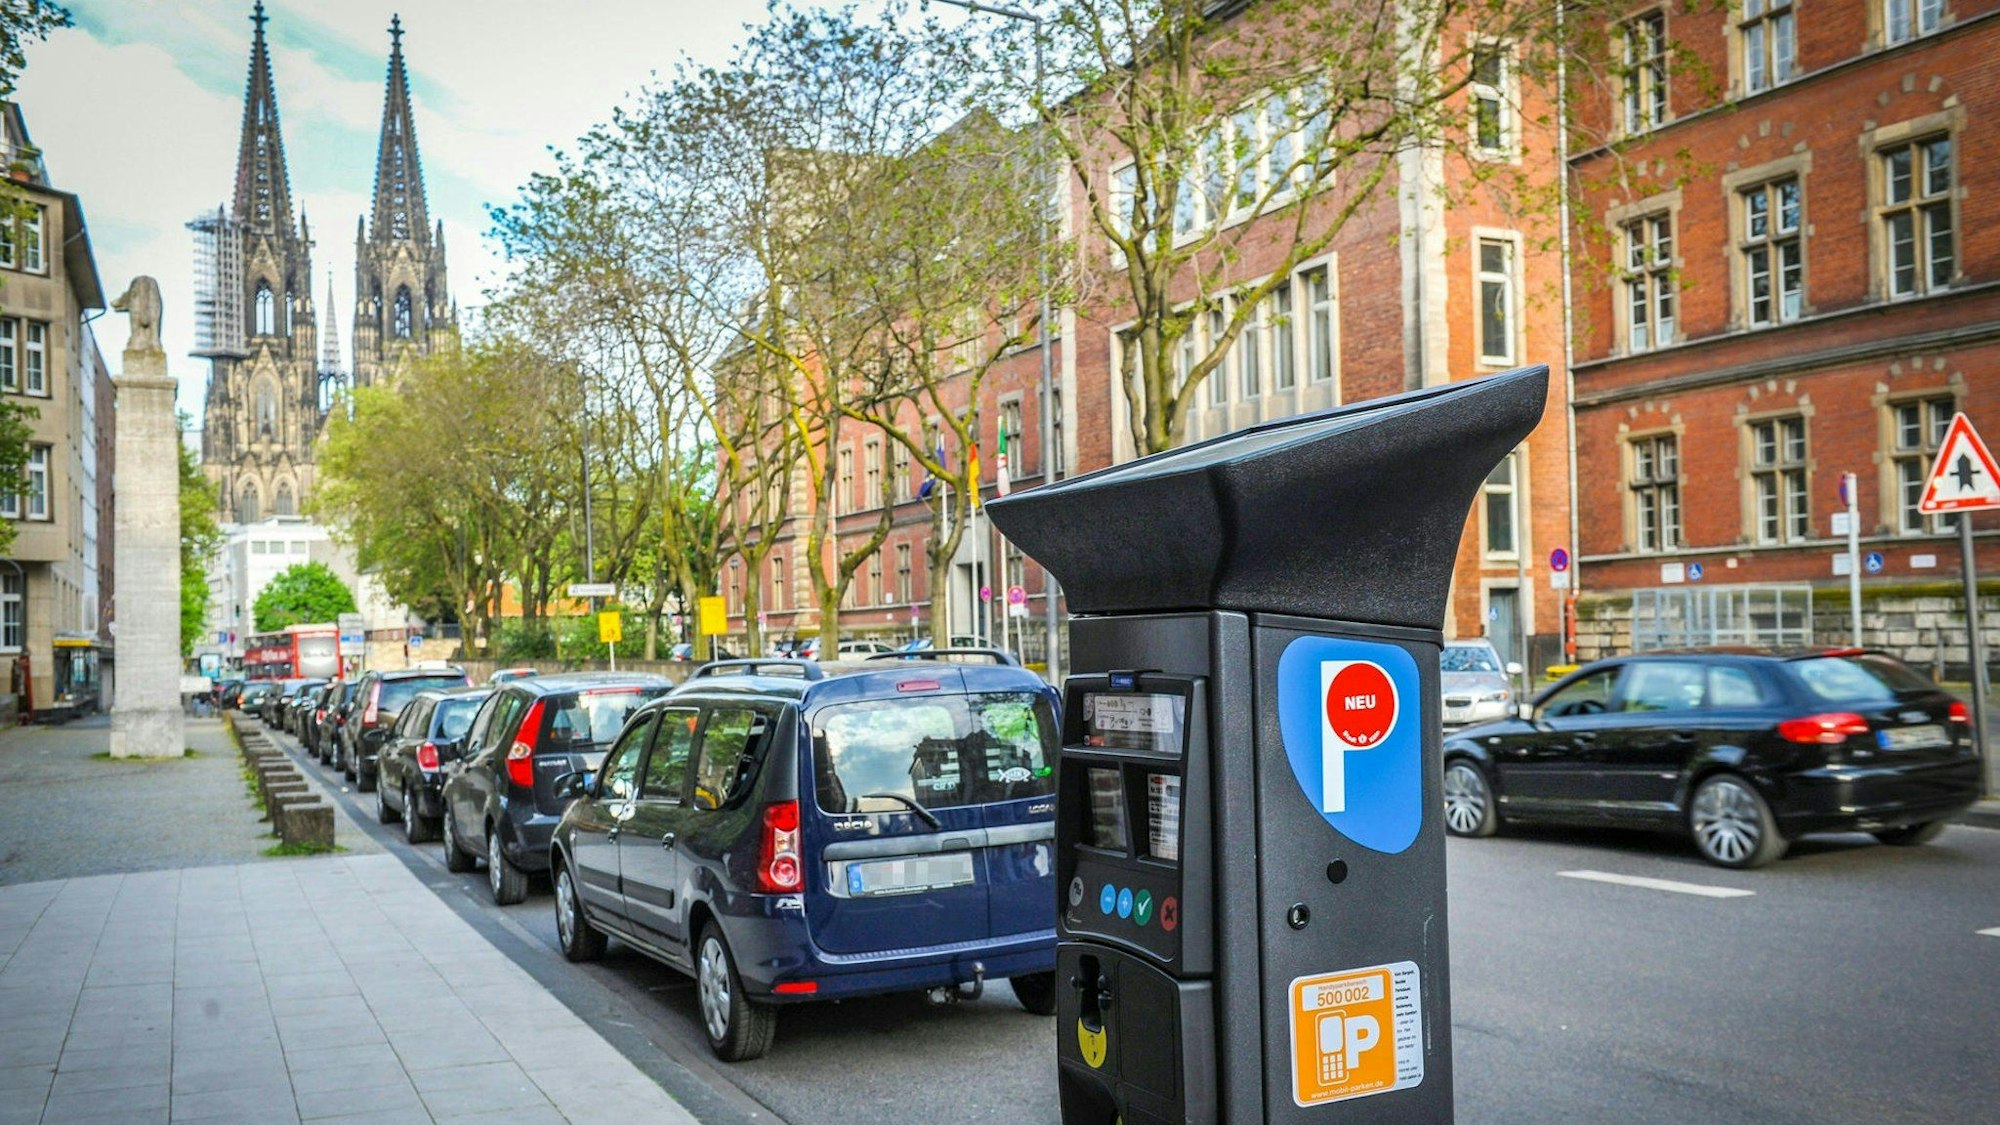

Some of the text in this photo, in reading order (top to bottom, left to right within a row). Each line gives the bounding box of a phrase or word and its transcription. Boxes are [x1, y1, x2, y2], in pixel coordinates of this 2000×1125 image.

[1344, 694, 1376, 710] NEU
[1321, 660, 1399, 812] P
[1317, 986, 1369, 1007] 500 002
[1344, 1015, 1380, 1069] P
[1311, 1080, 1384, 1098] www.mobil-parken.de
